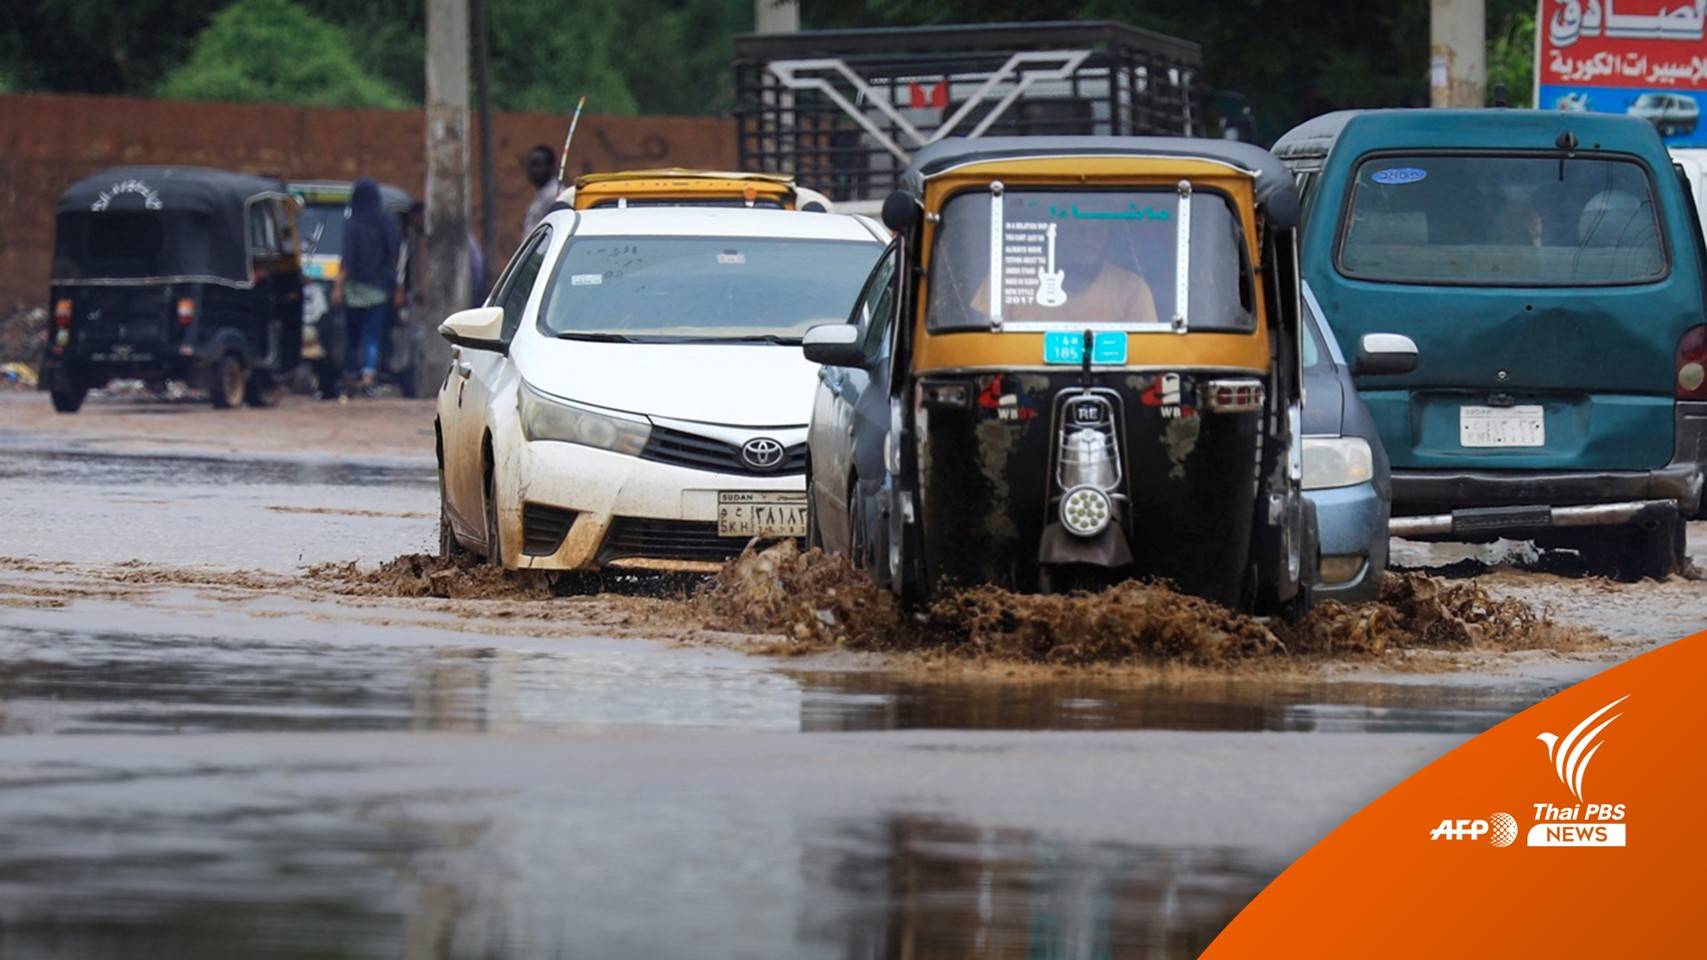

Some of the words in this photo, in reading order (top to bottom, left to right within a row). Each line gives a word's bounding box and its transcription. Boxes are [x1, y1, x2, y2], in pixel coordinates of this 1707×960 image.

[1549, 49, 1621, 81] الكورية
[1005, 295, 1035, 304] 2017
[1054, 347, 1079, 360] 185
[1078, 407, 1099, 420] RE
